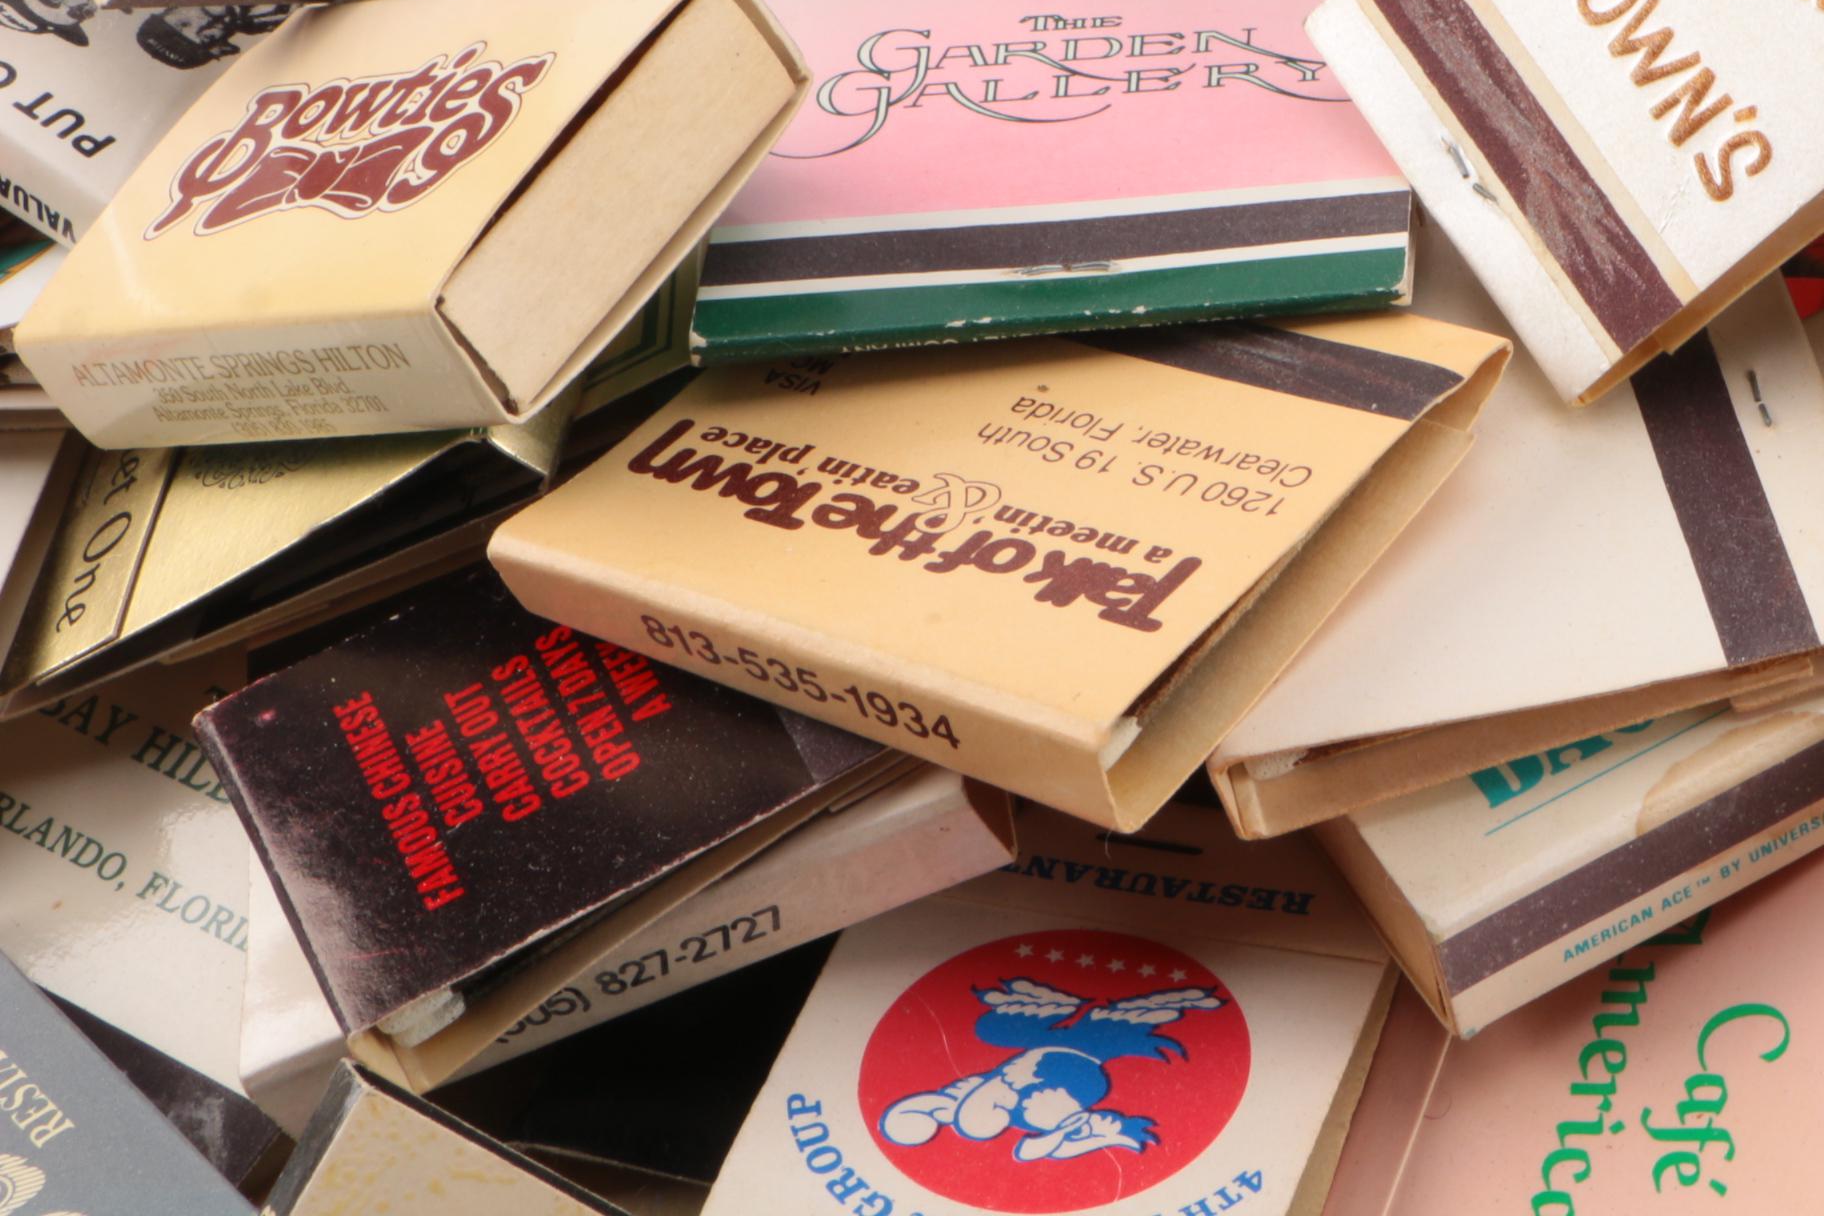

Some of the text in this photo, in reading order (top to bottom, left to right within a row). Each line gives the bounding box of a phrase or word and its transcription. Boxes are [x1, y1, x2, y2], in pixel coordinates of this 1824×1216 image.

[856, 26, 1260, 80] GARDEN
[1020, 13, 1122, 31] THE
[14, 89, 117, 160] PUT
[144, 40, 557, 240] Bowties
[70, 342, 413, 389] ALTAMONTE SPRINGS HILTON
[179, 384, 224, 403] South
[226, 381, 274, 402] North
[275, 378, 311, 398] Lake
[762, 366, 825, 396] VISA
[976, 420, 1287, 520] 1260 U.S. 19 South
[1010, 395, 1315, 489] Clearwater, Florida
[627, 417, 1203, 634] Talk of the Town
[699, 423, 1174, 564] a & place
[491, 655, 591, 800] COCKTAILS
[631, 692, 673, 722] A
[639, 613, 962, 750] 813-535-1934
[404, 719, 485, 827] CUISINE
[443, 682, 543, 822] CARRY OUT
[576, 703, 642, 782] OPEN
[331, 689, 466, 912] FAMOUS CHINESE
[595, 903, 784, 996] 827-2727
[1561, 904, 1655, 964] AMERICAN
[1717, 857, 1743, 880] BY
[1641, 1002, 1791, 1197] Café
